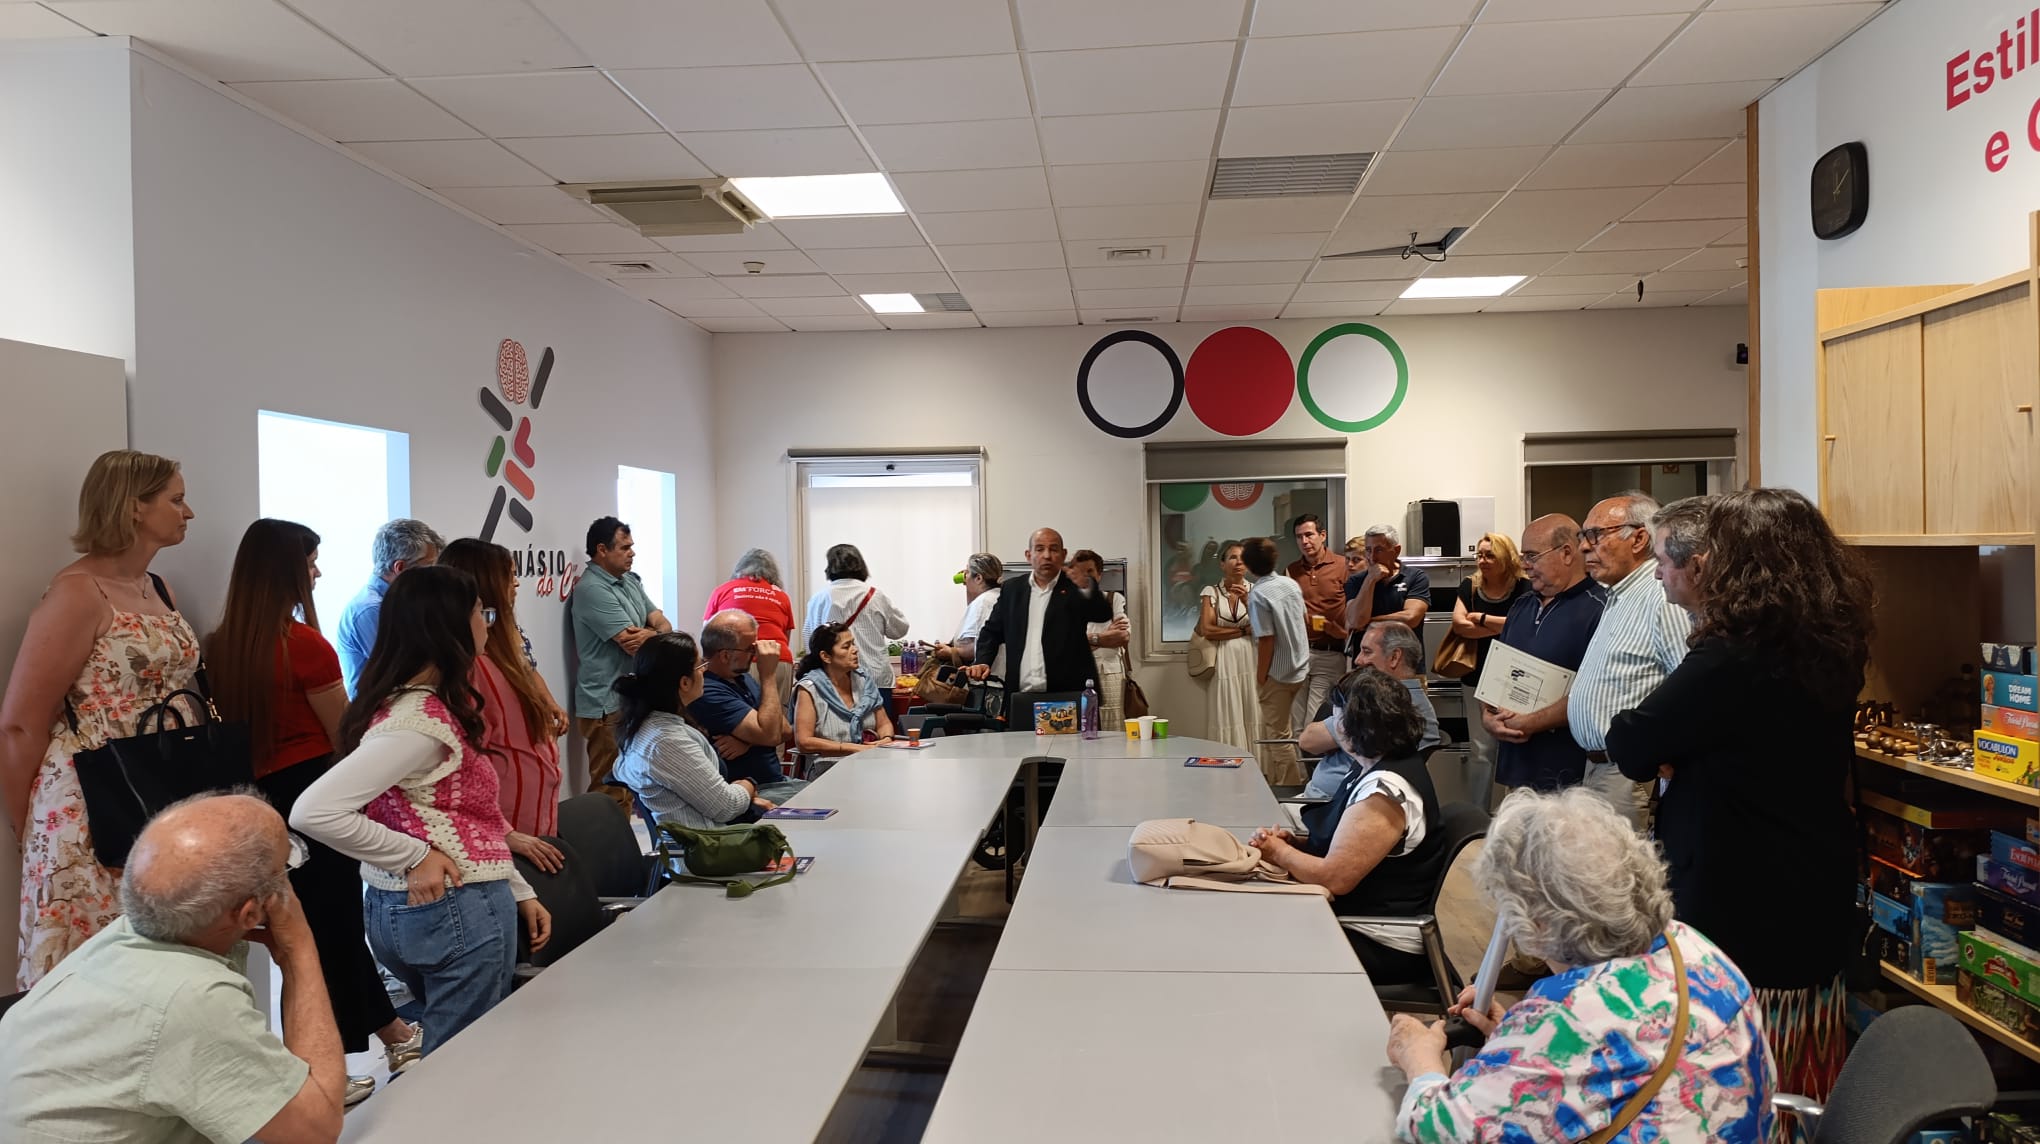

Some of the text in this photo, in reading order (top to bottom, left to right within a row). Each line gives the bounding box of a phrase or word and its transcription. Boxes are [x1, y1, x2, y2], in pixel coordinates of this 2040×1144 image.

[1946, 8, 2040, 111] Estil
[1985, 130, 2010, 172] e
[2008, 684, 2032, 695] DREAM
[2009, 693, 2032, 705] HOME
[1978, 739, 2017, 758] VOCABULON
